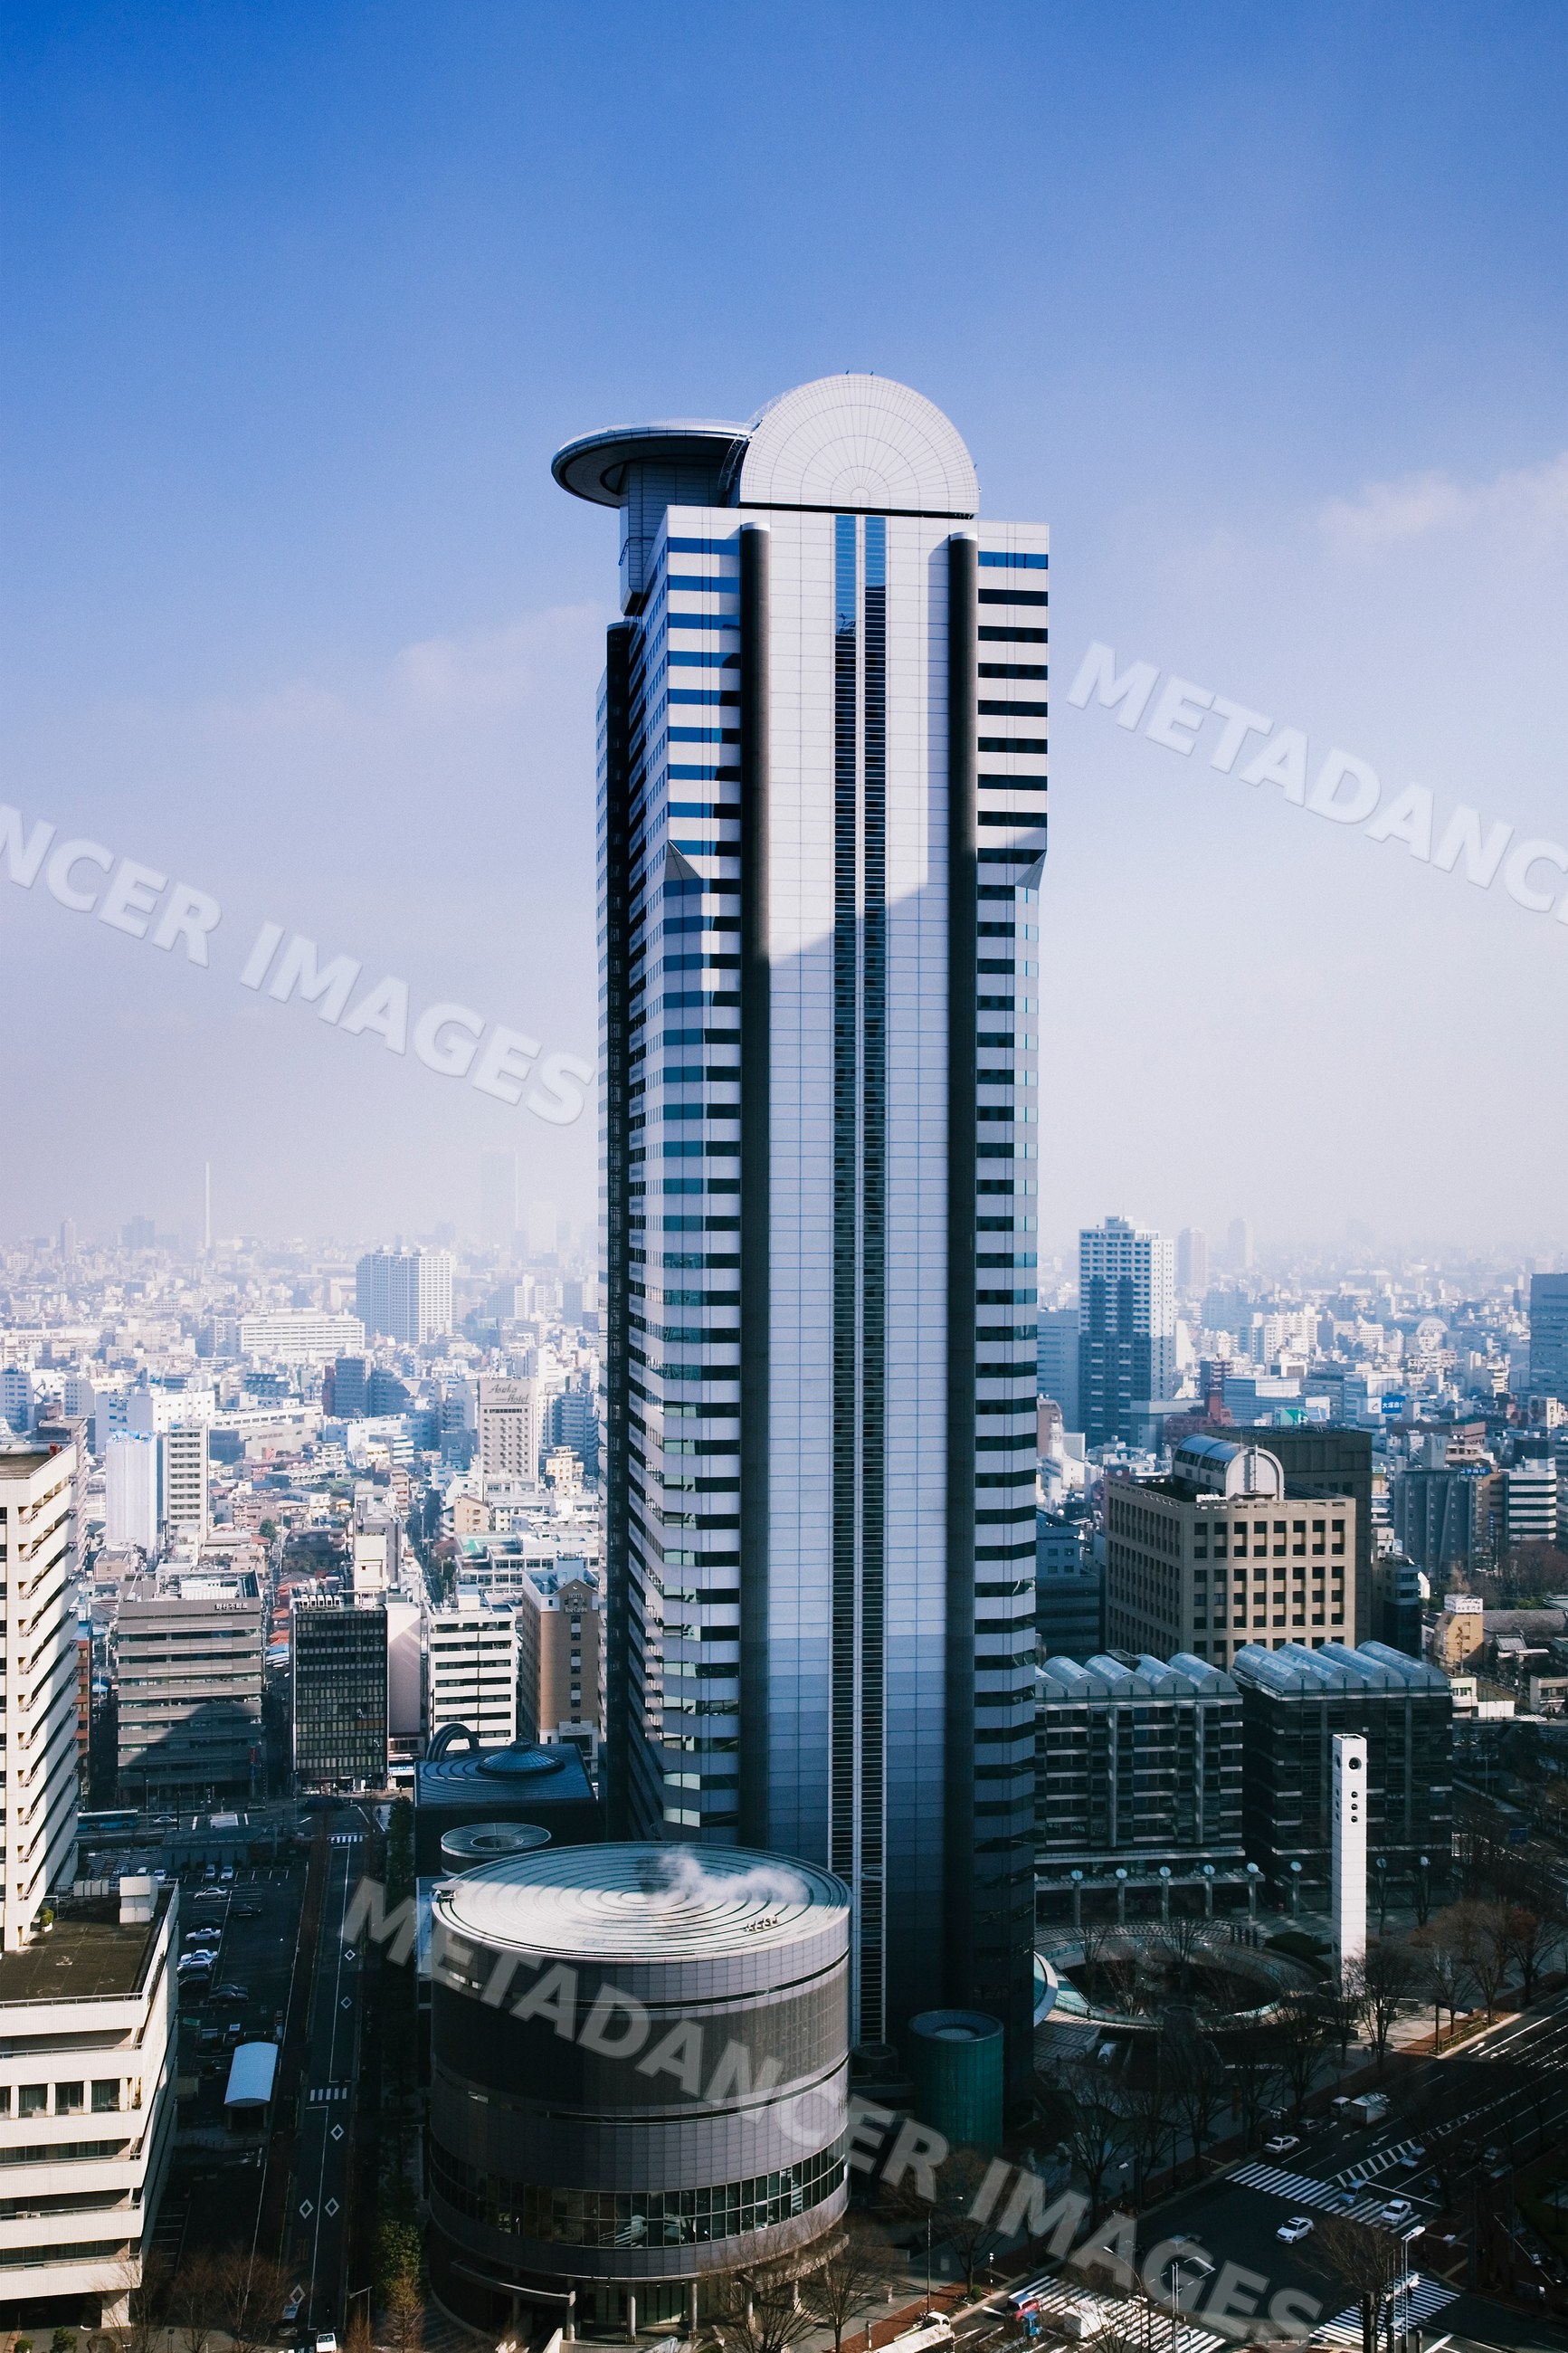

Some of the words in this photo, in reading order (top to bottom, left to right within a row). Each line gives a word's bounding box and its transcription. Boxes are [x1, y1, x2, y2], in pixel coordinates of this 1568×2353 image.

[507, 1394, 529, 1403] Hotel
[214, 1602, 248, 1610] 野村不動産
